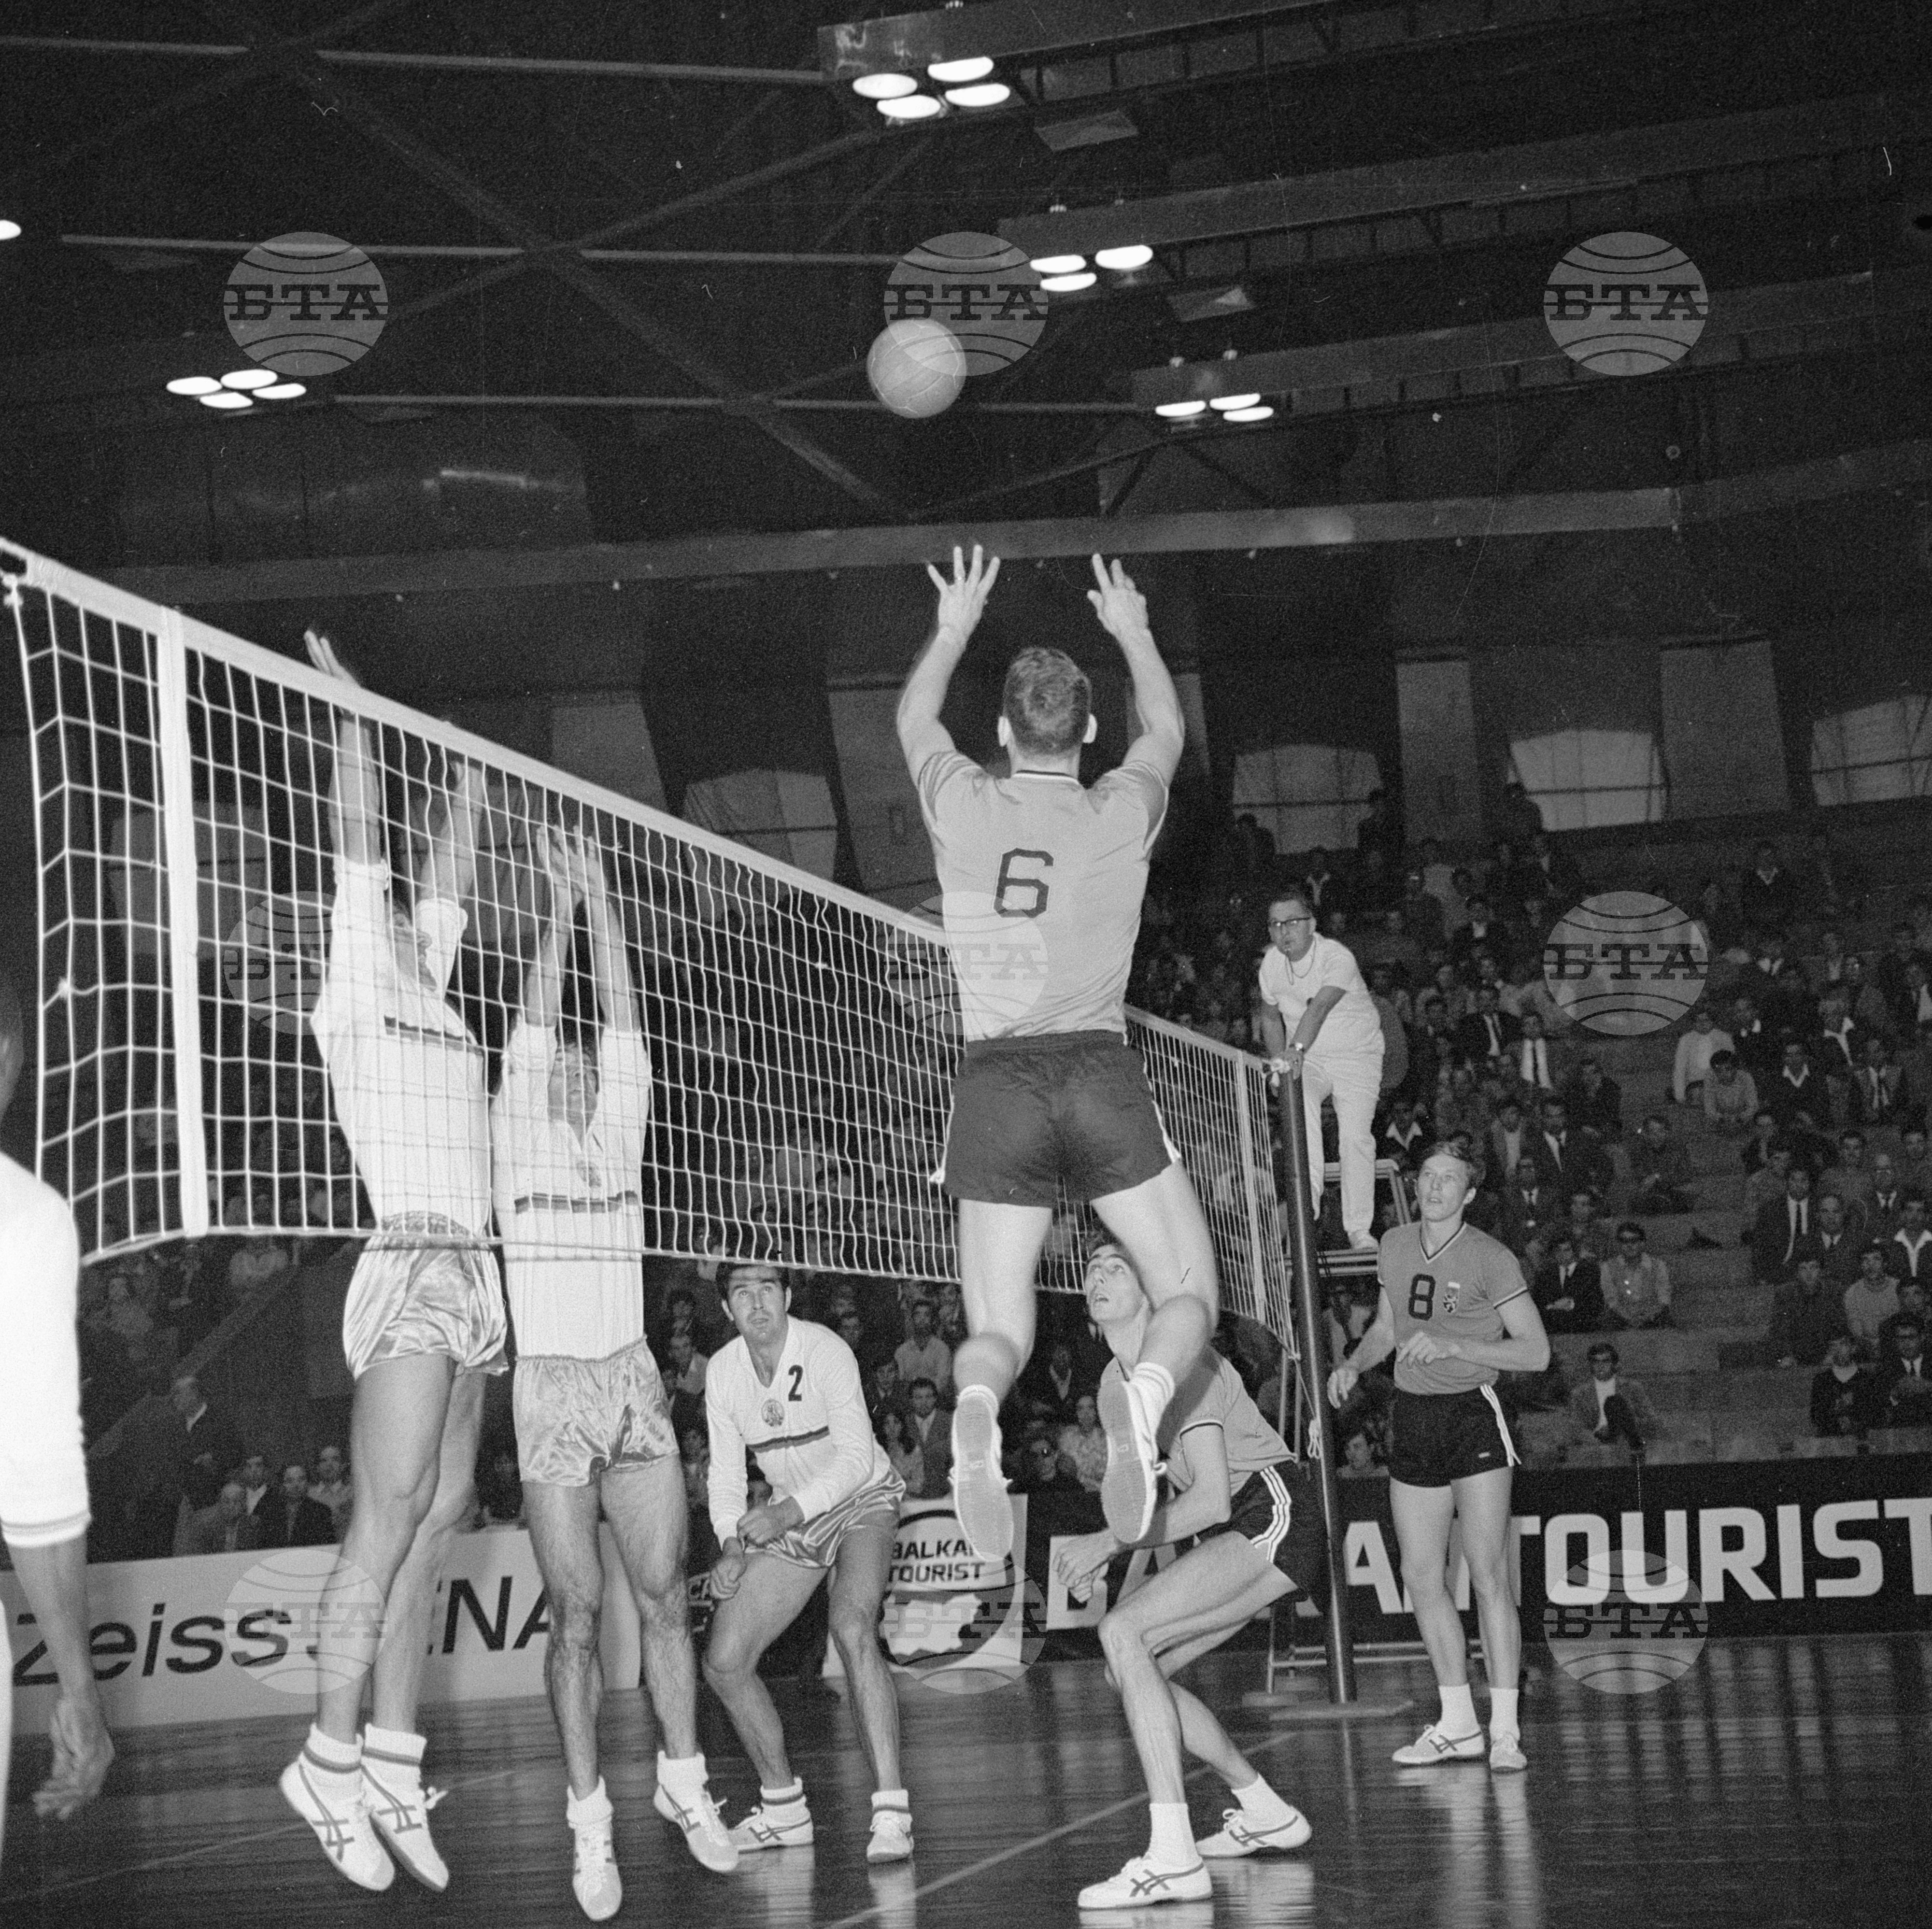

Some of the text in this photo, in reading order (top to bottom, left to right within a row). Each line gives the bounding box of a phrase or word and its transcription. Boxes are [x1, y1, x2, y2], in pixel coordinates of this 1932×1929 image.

[994, 848, 1053, 918] 6
[1409, 1274, 1435, 1321] 8
[788, 1364, 803, 1401] 2
[888, 1562, 985, 1583] TOURIST
[1046, 1498, 1932, 1630] BAATOURIST
[13, 1603, 292, 1687] Zeiss
